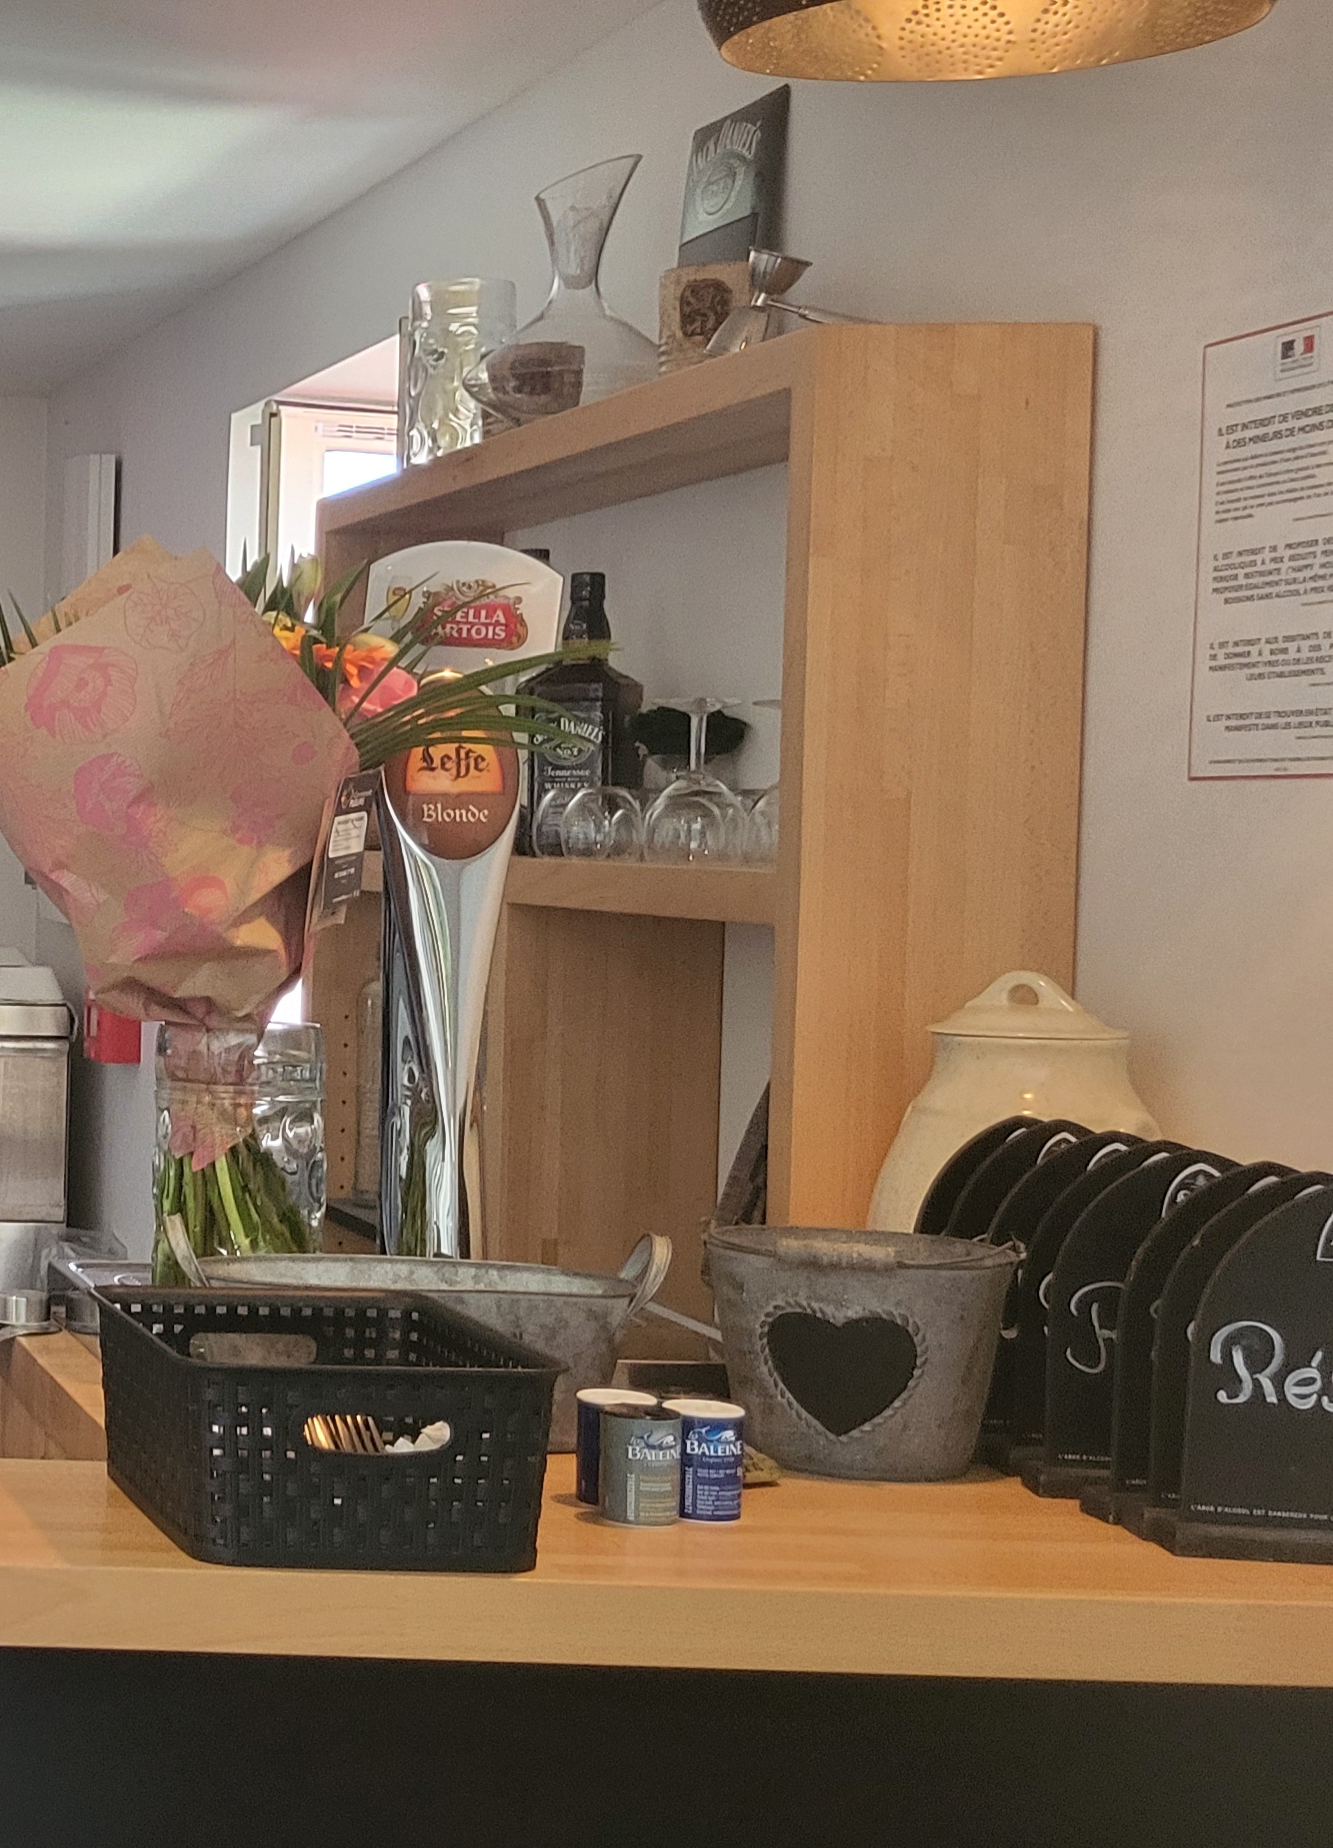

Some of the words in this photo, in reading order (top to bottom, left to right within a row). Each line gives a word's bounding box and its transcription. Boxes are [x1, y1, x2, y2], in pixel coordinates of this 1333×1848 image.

[433, 606, 506, 624] SELLA
[417, 743, 489, 782] Leffe
[422, 802, 489, 822] Blonde
